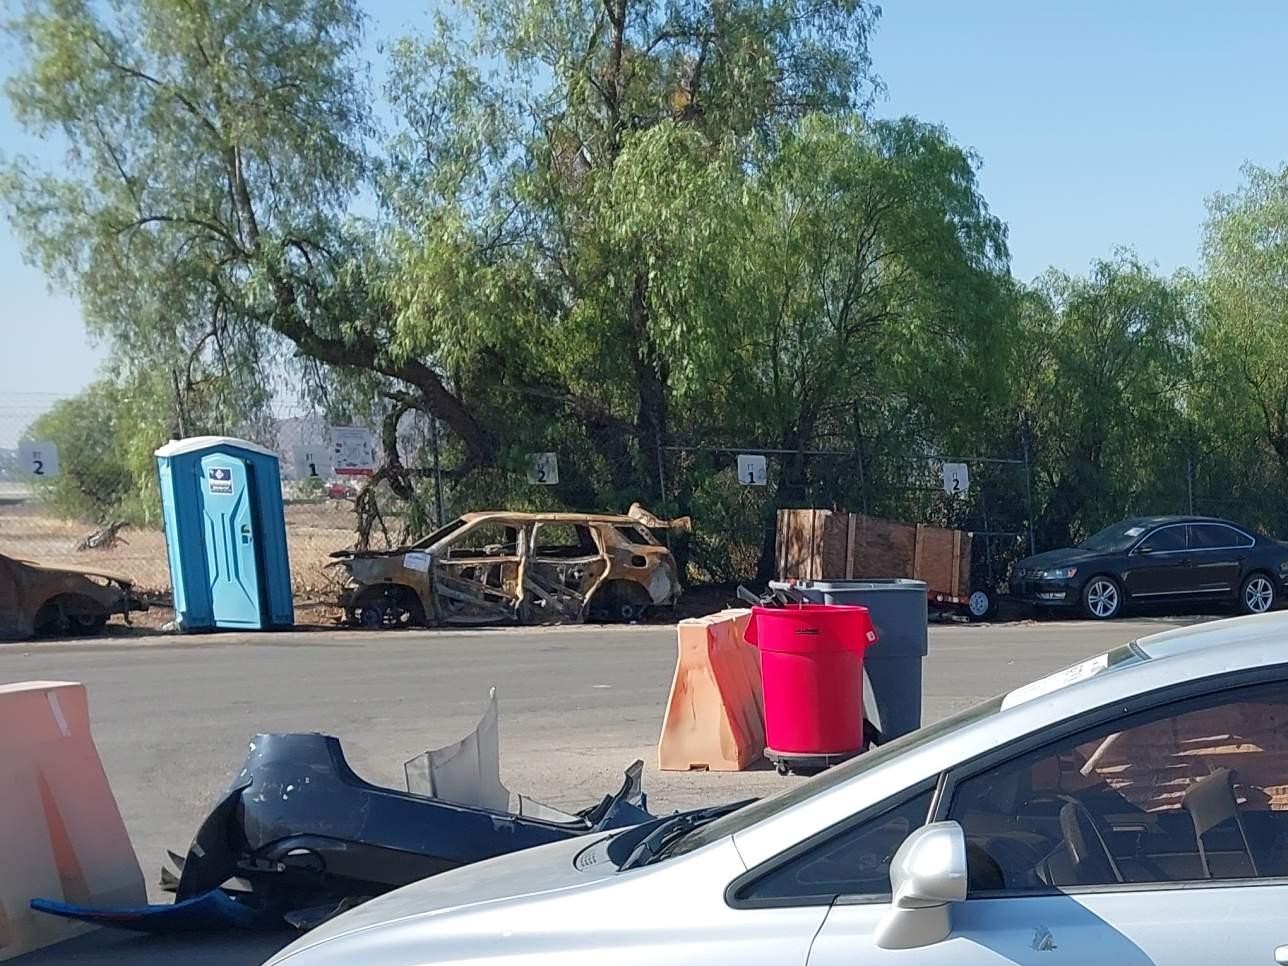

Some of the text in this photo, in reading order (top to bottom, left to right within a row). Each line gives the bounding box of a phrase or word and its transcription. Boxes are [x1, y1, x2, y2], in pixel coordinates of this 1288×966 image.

[32, 460, 45, 475] 2
[309, 463, 319, 477] 1
[537, 470, 547, 483] 2
[748, 471, 756, 484] 1
[953, 478, 960, 491] 2
